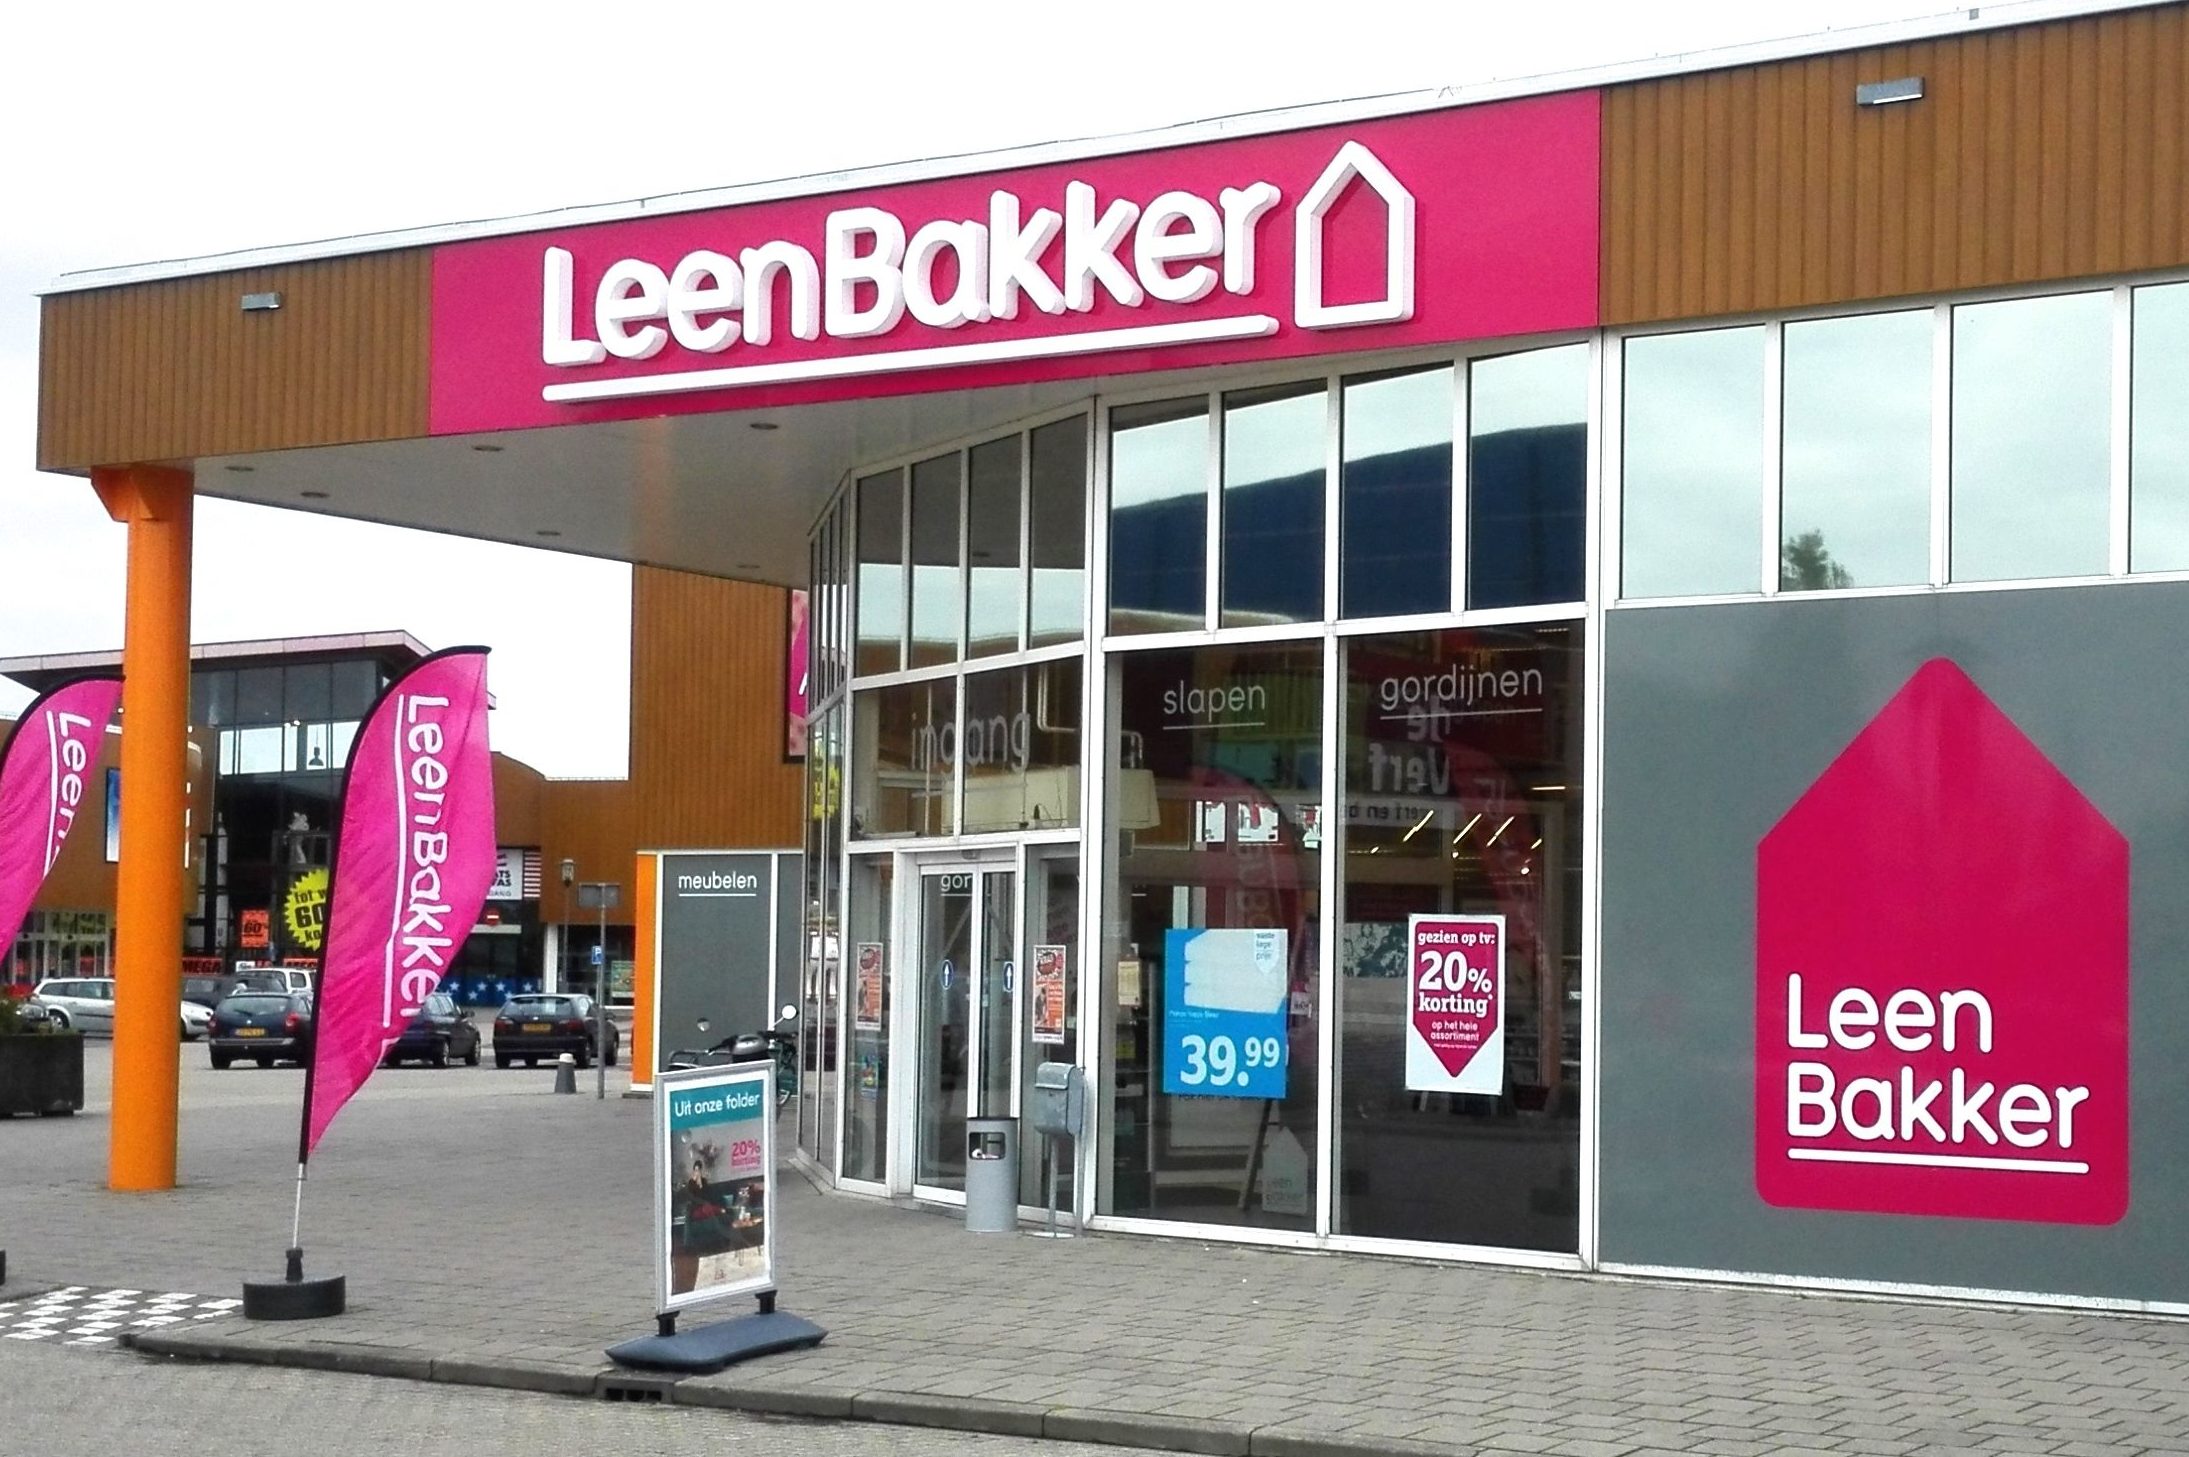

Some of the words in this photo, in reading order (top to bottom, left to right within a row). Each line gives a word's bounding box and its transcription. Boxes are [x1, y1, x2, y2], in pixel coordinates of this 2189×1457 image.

[543, 180, 1280, 367] LeenBakker
[1162, 679, 1266, 723] slapen
[1380, 663, 1543, 709] gordijnen
[911, 711, 1031, 780] ingang
[678, 870, 758, 890] meubelen
[1417, 929, 1459, 946] gezien
[1461, 934, 1477, 947] op
[1479, 931, 1495, 945] tv:
[1418, 949, 1493, 993] 20%
[1431, 1021, 1443, 1030] op
[1444, 1020, 1458, 1030] het
[1787, 972, 1993, 1054] Leen
[1430, 1031, 1480, 1042] assortiment
[1180, 1034, 1280, 1087] 39.99
[674, 1100, 692, 1117] Uit
[694, 1099, 723, 1114] onze
[726, 1092, 760, 1110] folder
[1787, 1061, 2090, 1149] Bakker
[732, 1139, 761, 1157] 20%
